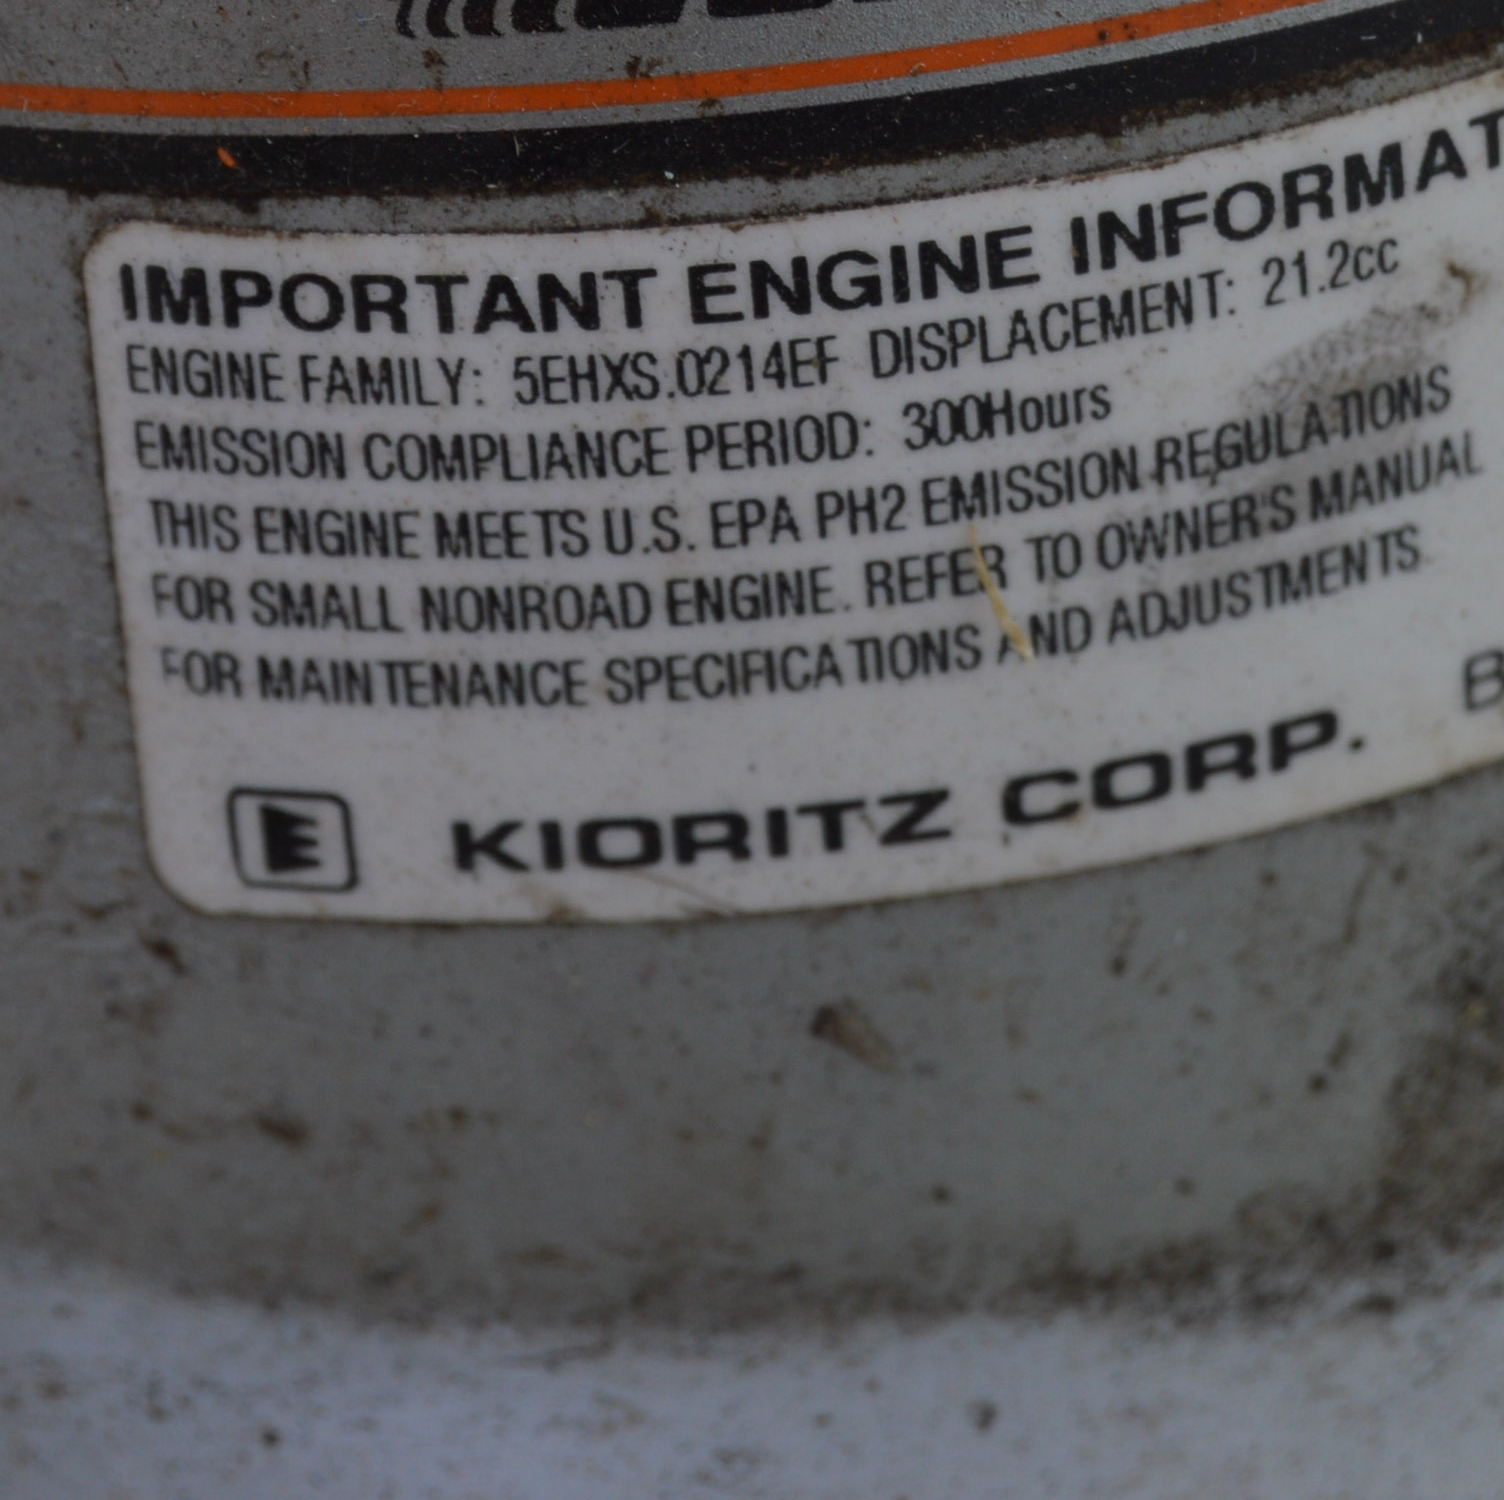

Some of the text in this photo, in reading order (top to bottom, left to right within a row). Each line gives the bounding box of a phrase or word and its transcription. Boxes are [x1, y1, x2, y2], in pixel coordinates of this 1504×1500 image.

[120, 265, 656, 334] IMPORTANT
[687, 226, 1039, 327] ENGINE
[127, 236, 1400, 406] ENGINE FAMILY: 5EHXS.0214EF DISPLACEMENT: 21.2cc
[135, 382, 1112, 483] EMISSION COMPLIANCE PERIOD: 300Hours
[149, 365, 1453, 560] THIS ENGINE MEETS U.S. EPA PH2 EMISSION REGULATIONS
[150, 429, 1483, 633] FOR SMALL NONROAD ENGINE. REFER TO OWNER'S MANUAL
[161, 649, 242, 699] FOR
[257, 655, 587, 708] MAINTENANCE
[605, 623, 982, 704] SPECIFICATIONS
[1108, 524, 1423, 645] ADJUSTMENTS
[451, 710, 1365, 872] KIORITZ CORP.
